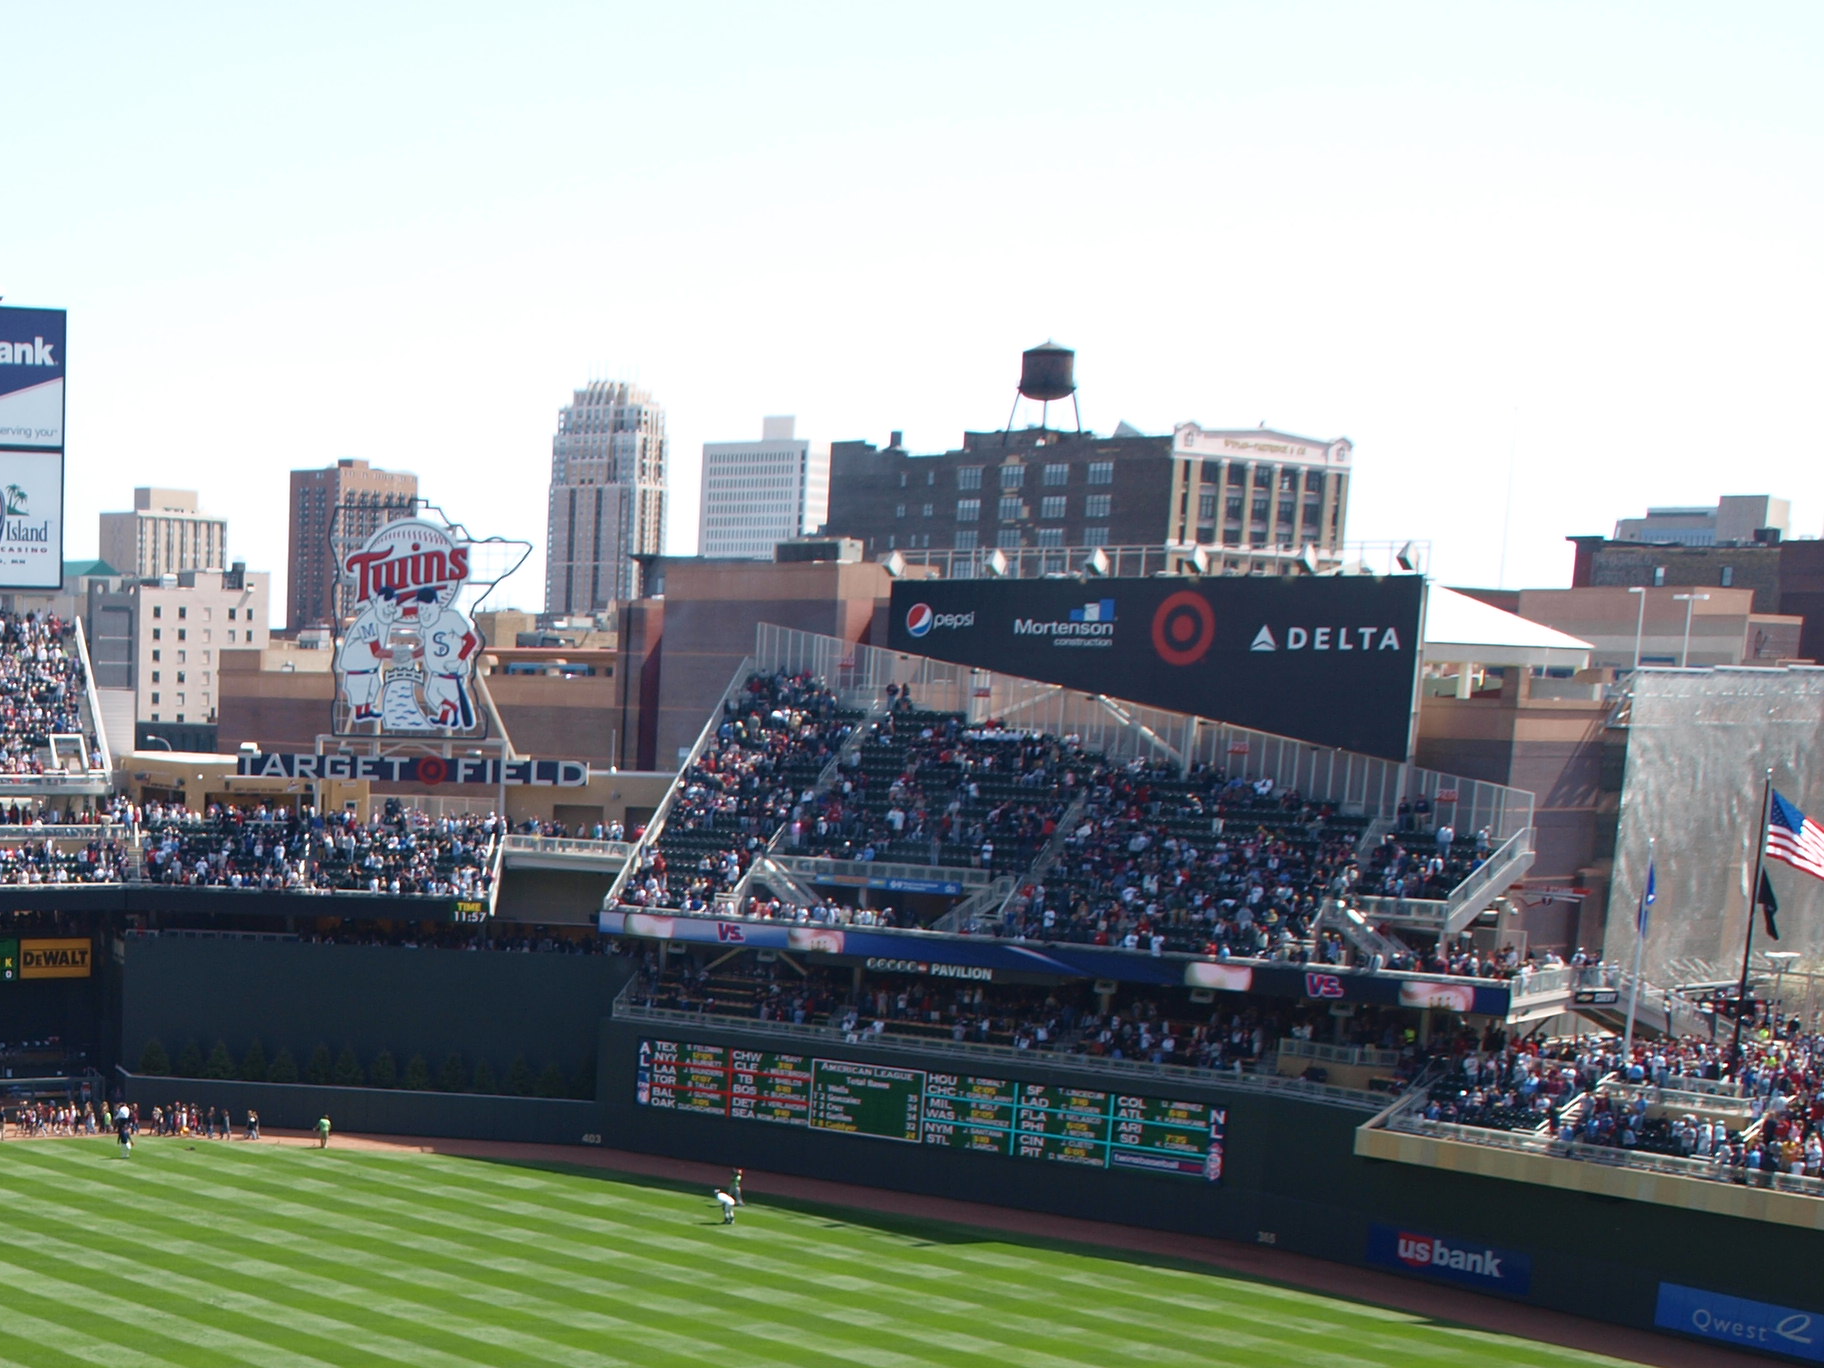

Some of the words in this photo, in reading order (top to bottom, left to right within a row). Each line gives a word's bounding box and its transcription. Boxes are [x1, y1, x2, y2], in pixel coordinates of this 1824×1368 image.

[5, 520, 48, 542] Island
[346, 543, 469, 602] Twins
[933, 611, 975, 632] pepsi
[1014, 618, 1115, 636] Mortenson
[1053, 637, 1114, 648] construction
[1286, 626, 1401, 651] DELTA
[238, 753, 411, 782] TARGET
[457, 758, 591, 787] FIELD
[457, 902, 482, 913] TIME
[454, 910, 487, 923] 11:57
[931, 963, 992, 981] PAVILION
[655, 1041, 677, 1052] TEX
[654, 1051, 677, 1062] NYY
[732, 1050, 761, 1062] CHW
[654, 1063, 676, 1074] LAA
[734, 1060, 757, 1071] CLE
[653, 1074, 676, 1084] TOR
[738, 1074, 752, 1084] TB
[874, 1069, 912, 1080] LEAGUE
[928, 1074, 957, 1085] HOU
[652, 1086, 674, 1097] BAL
[733, 1083, 756, 1094] BOS
[927, 1084, 955, 1095] CHC
[1026, 1085, 1044, 1096] SF
[651, 1096, 675, 1108] OAK
[732, 1097, 756, 1107] DET
[929, 1098, 952, 1109] MIL
[1020, 1096, 1048, 1107] LAD
[1117, 1096, 1147, 1109] COL
[732, 1108, 754, 1118] SEA
[925, 1108, 954, 1120] WAS
[1020, 1109, 1047, 1121] FLA
[1117, 1108, 1145, 1120] ATL
[924, 1122, 953, 1134] NYM
[1021, 1120, 1044, 1131] PHI
[1117, 1122, 1142, 1134] ARI
[581, 1132, 602, 1144] 403
[926, 1134, 950, 1145] STL
[1019, 1135, 1043, 1146] CIN
[1119, 1133, 1139, 1144] SD
[1020, 1146, 1042, 1157] PIT
[1692, 1308, 1767, 1342] Qwest
